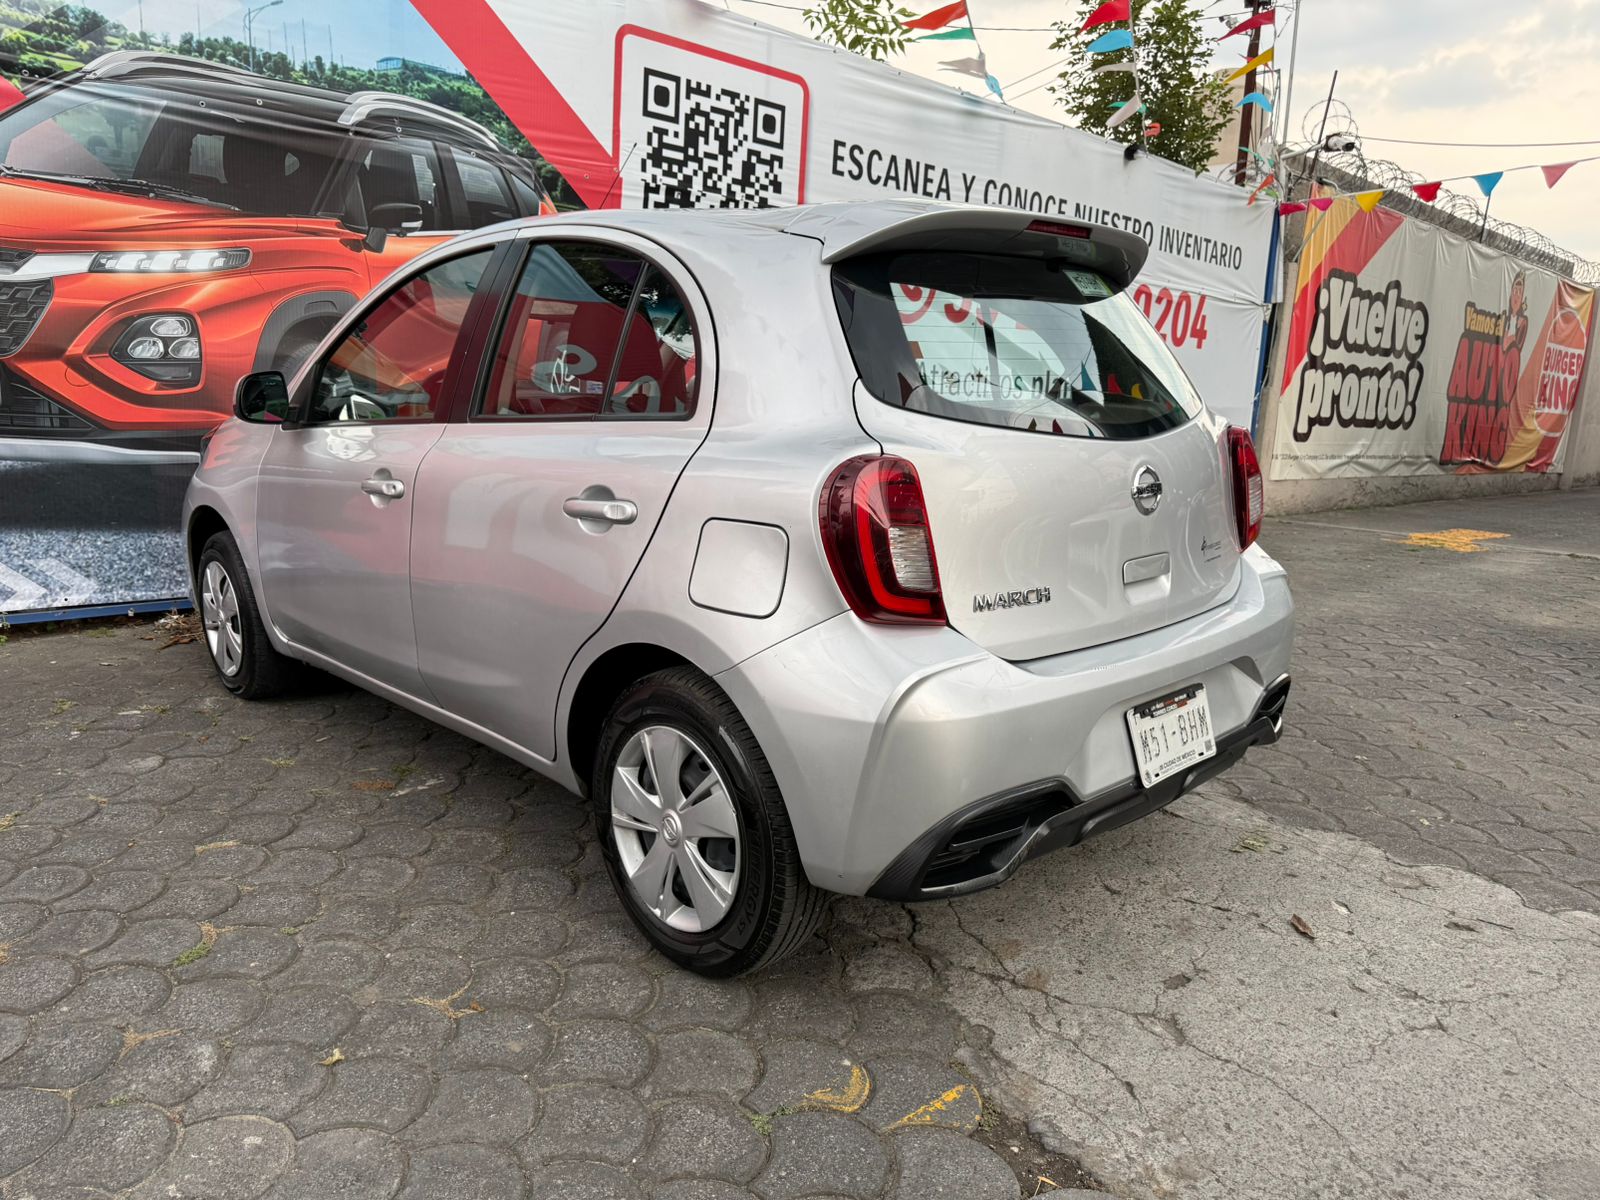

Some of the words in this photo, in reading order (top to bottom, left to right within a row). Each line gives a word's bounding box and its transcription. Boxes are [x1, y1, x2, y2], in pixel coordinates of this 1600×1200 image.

[832, 139, 951, 201] ESCANEA
[962, 173, 976, 202] Y
[984, 179, 1068, 215] CONOCE
[1074, 203, 1154, 247] NUESTRO
[1158, 225, 1243, 271] INVENTARIO
[1309, 272, 1427, 359] ¡Vuelve
[1465, 304, 1496, 336] Vamos
[1449, 336, 1521, 402] AUTO
[1542, 346, 1584, 377] BURGER
[1295, 364, 1421, 437] pronto!
[1441, 402, 1511, 465] KING
[972, 586, 1051, 613] MARCH
